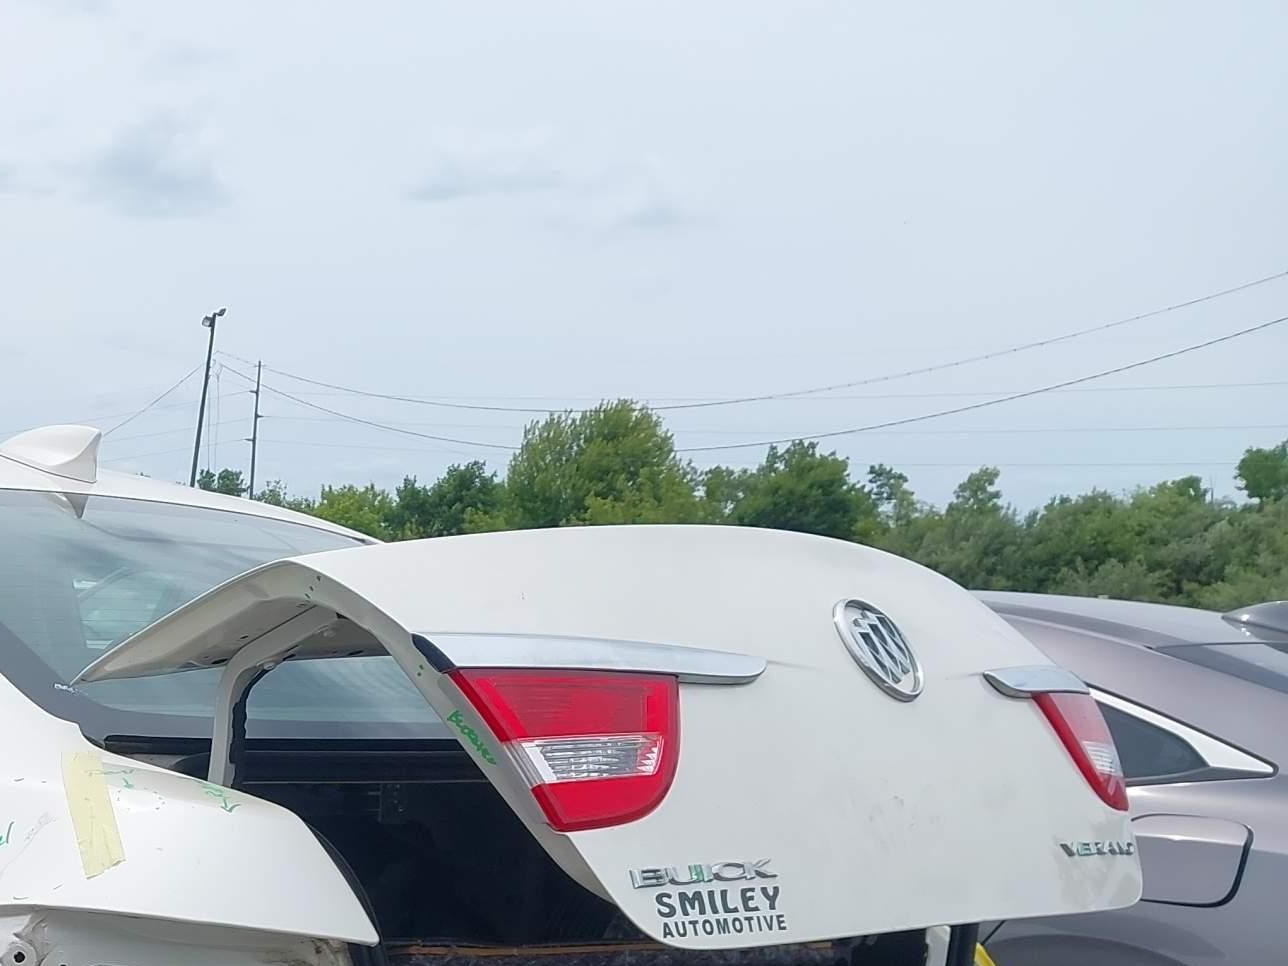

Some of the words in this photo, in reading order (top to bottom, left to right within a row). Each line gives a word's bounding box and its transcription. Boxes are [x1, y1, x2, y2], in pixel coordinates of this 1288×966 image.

[629, 857, 778, 889] BUICK
[655, 886, 780, 918] SMILEY
[663, 914, 787, 938] AUTOMOTIVE
